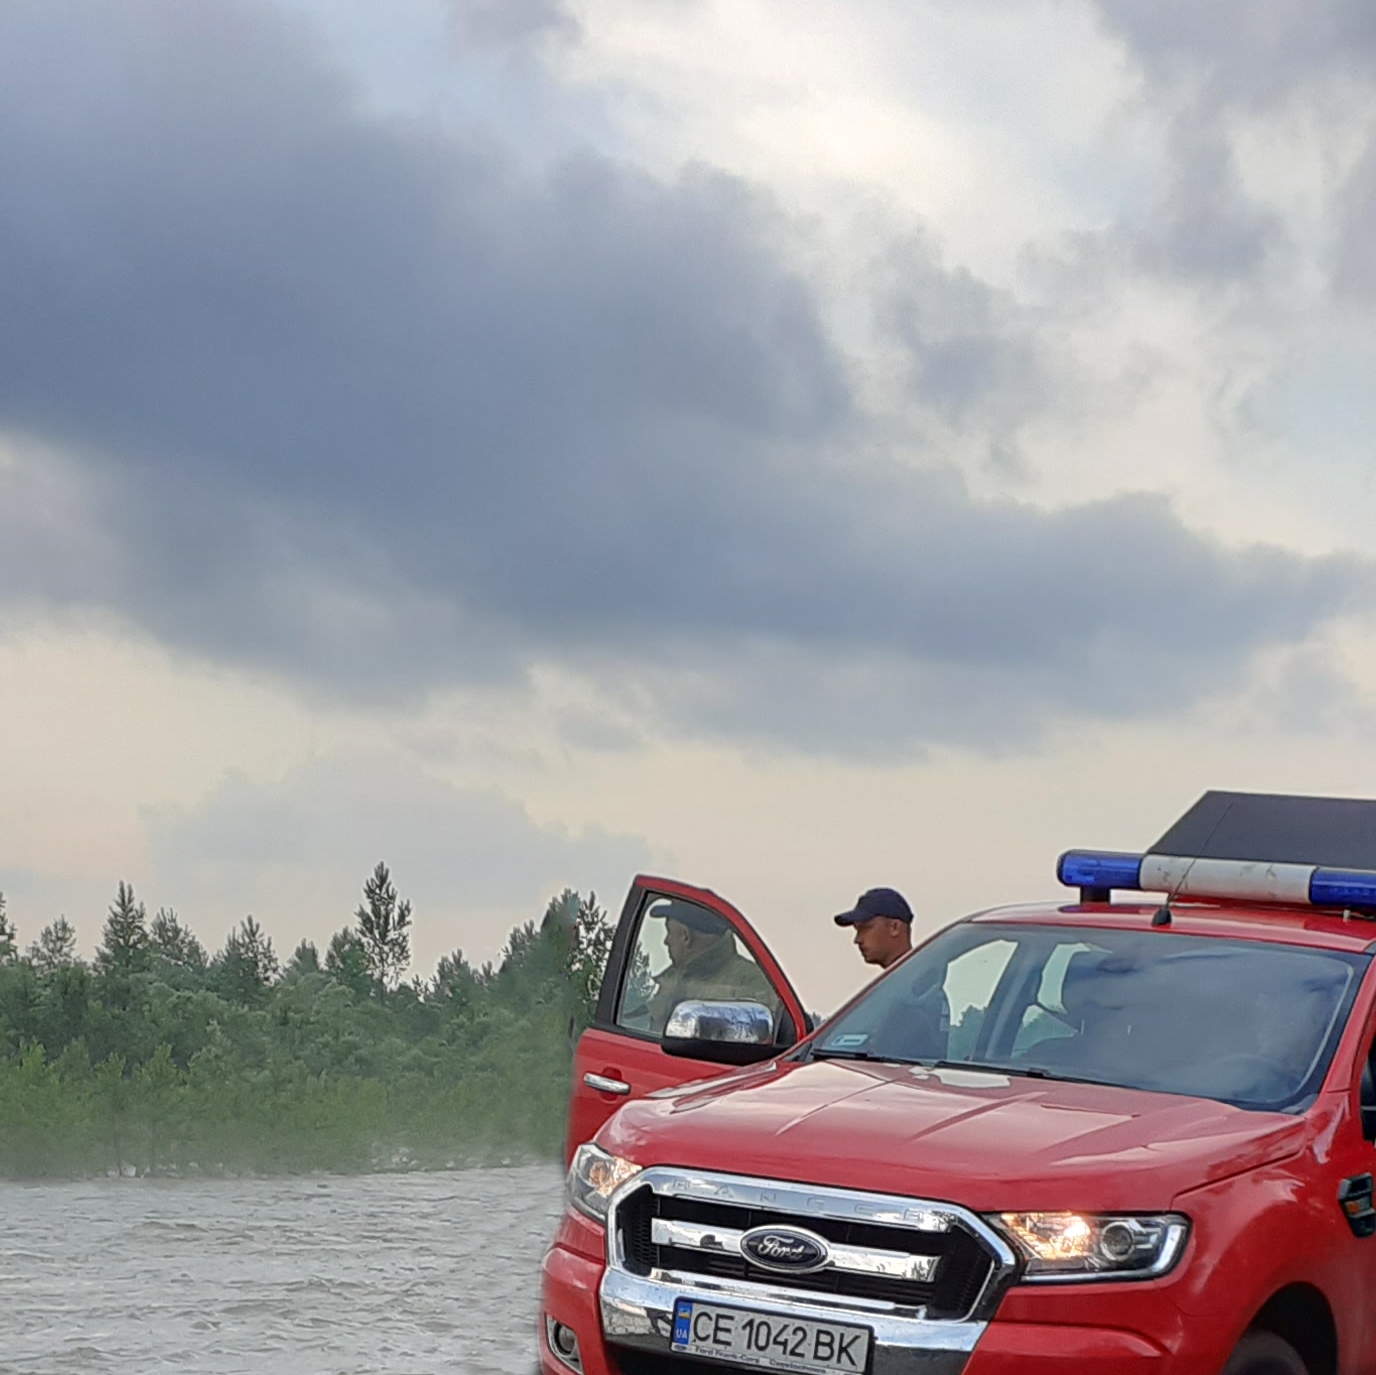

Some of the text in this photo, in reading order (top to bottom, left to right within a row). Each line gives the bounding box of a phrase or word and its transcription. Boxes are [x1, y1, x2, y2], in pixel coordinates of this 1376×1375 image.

[674, 1179, 923, 1222] RANGER
[757, 1234, 805, 1260] Ford
[676, 1328, 688, 1339] UA
[693, 1311, 861, 1367] CE 1042 BK
